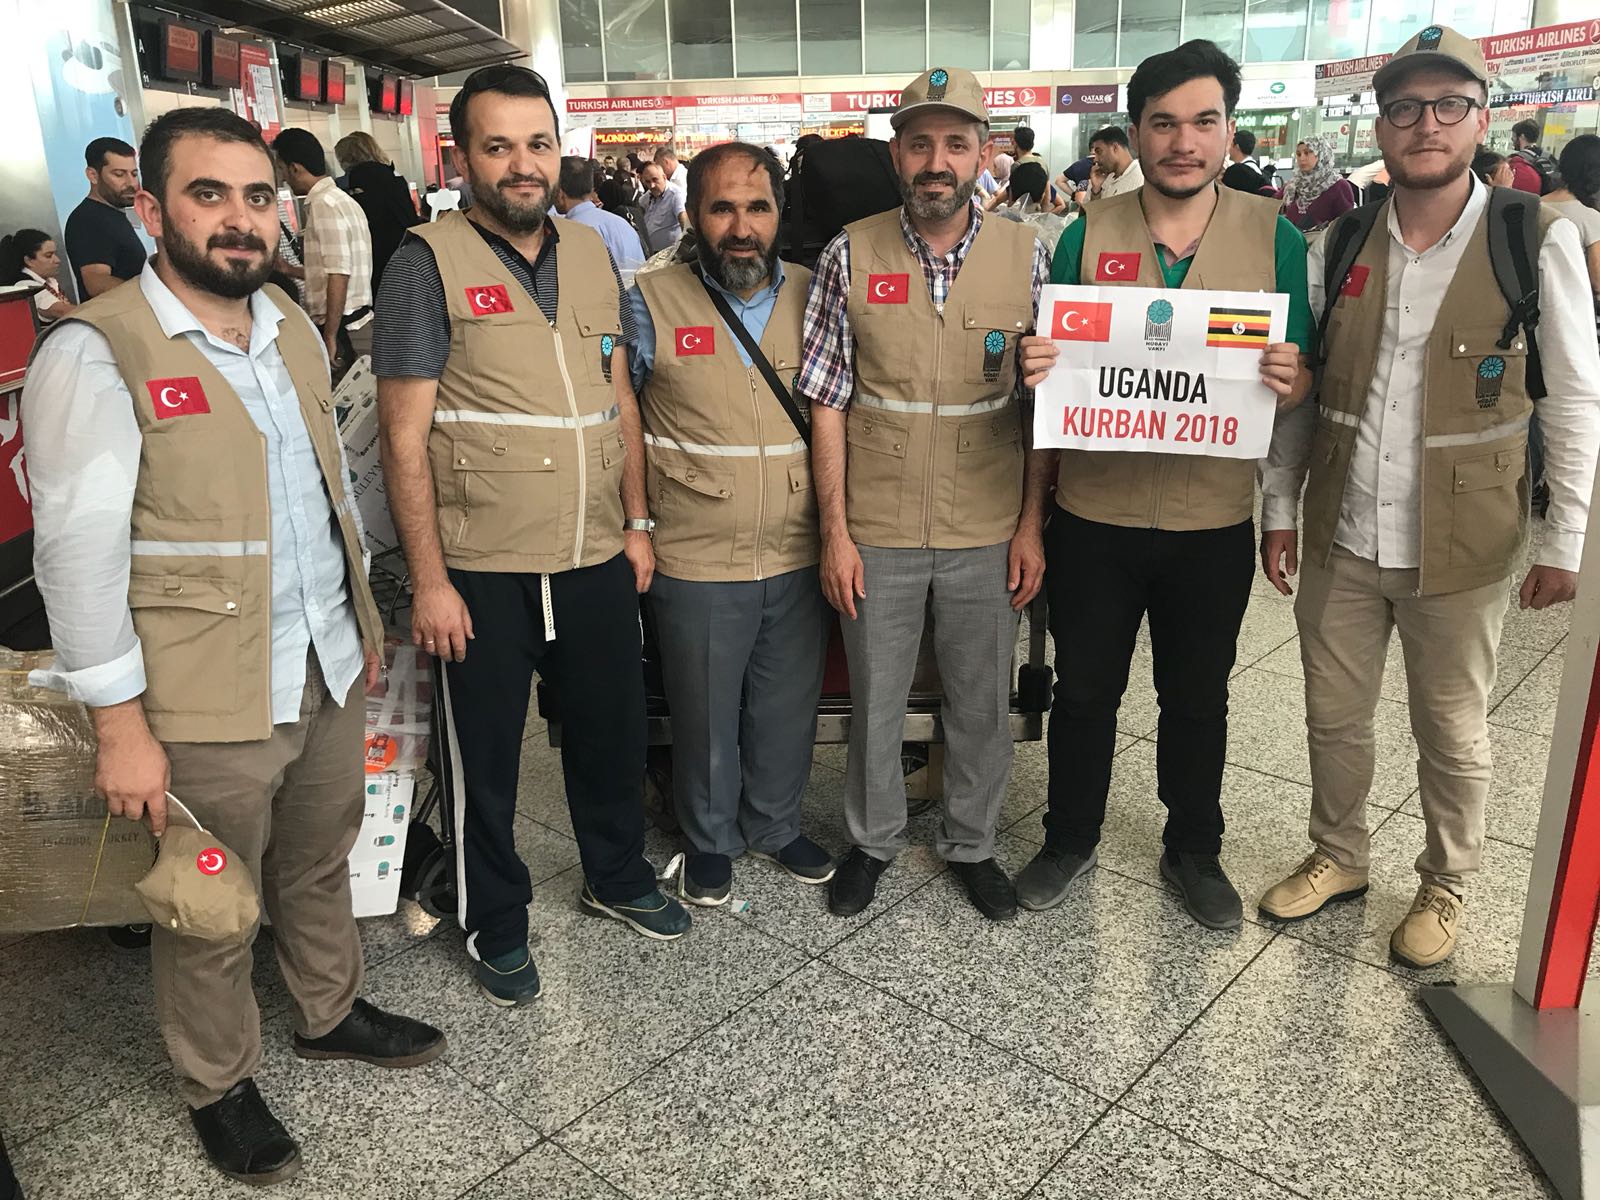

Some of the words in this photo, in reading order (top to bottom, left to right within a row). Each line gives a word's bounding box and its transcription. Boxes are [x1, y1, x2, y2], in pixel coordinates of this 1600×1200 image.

[1490, 35, 1534, 55] TURKISH
[1536, 26, 1586, 49] AIRLINES
[1327, 63, 1354, 77] TURKISH
[1354, 55, 1384, 73] AIRLINES
[568, 101, 609, 111] TURKISH
[611, 99, 654, 109] AIRLINES
[697, 97, 733, 105] TURKISH
[733, 96, 768, 104] AIRLINES
[1080, 95, 1104, 103] QATAR
[600, 133, 640, 143] LONDON
[1099, 366, 1207, 404] UGANDA
[1063, 405, 1167, 441] KURBAN
[1174, 413, 1239, 446] 2018
